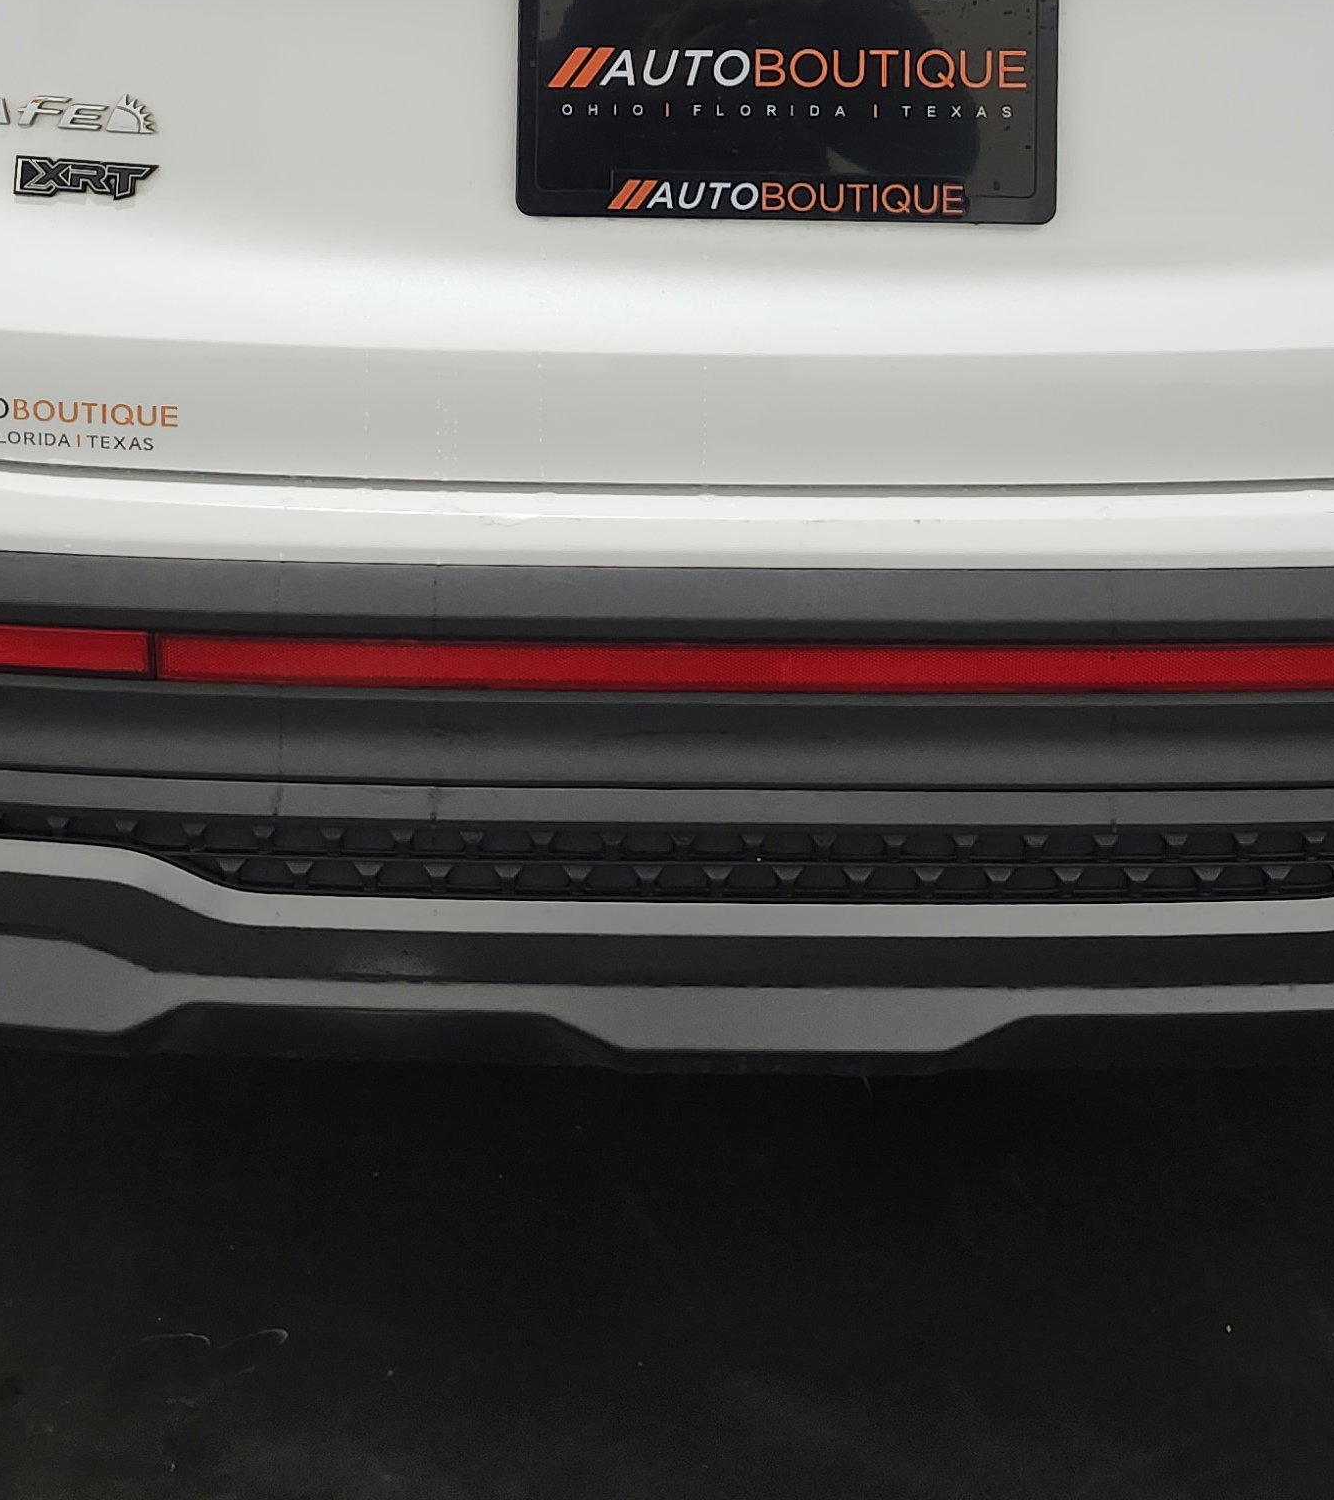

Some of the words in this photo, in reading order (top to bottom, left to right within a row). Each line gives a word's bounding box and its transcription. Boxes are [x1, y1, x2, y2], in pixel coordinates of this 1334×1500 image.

[17, 95, 109, 131] FE
[561, 104, 644, 118] OHIO
[693, 104, 847, 118] FLORIDA
[902, 105, 1013, 119] TEXAS
[19, 156, 158, 200] XRT
[86, 434, 155, 451] TEXAS
